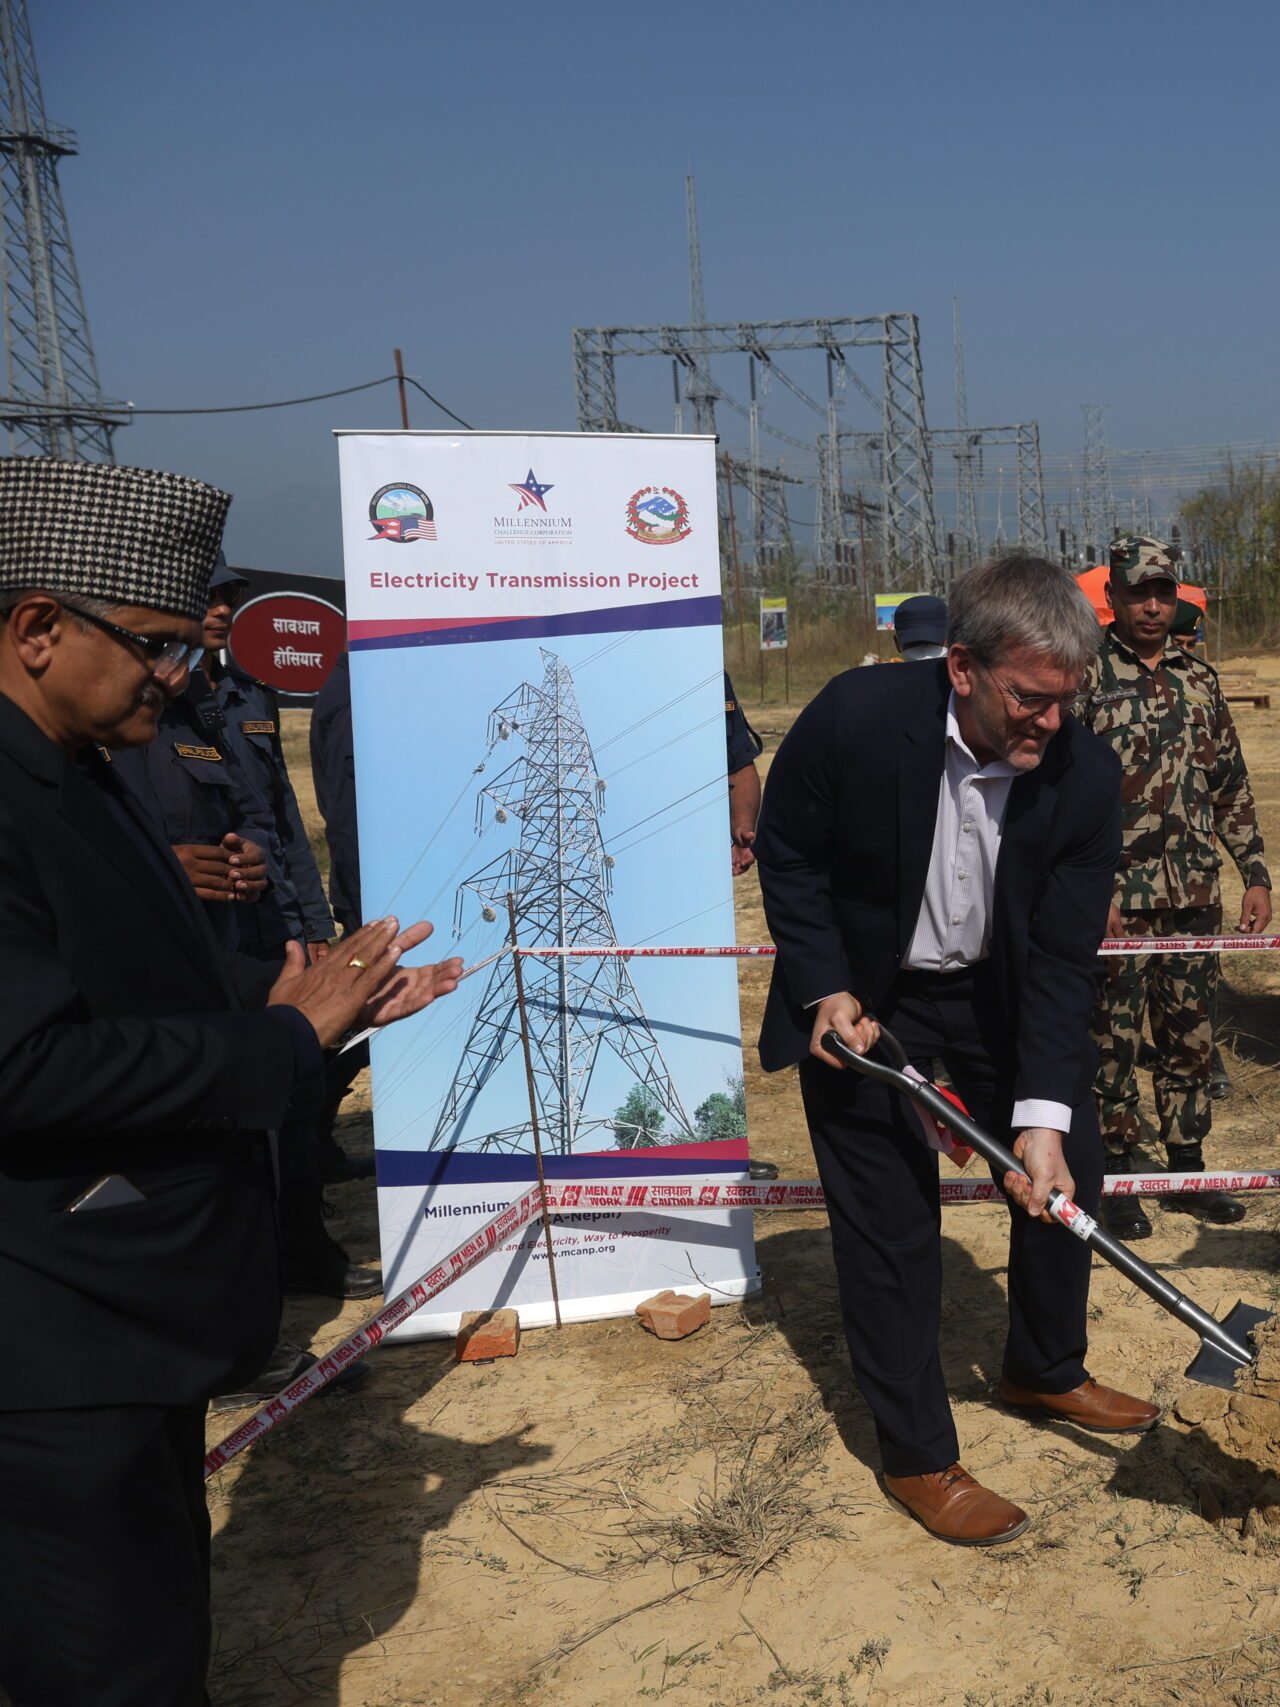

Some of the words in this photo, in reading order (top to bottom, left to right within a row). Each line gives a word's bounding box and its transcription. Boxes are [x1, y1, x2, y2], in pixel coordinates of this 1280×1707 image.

[494, 516, 572, 528] MILLENNIUM
[370, 571, 479, 591] Electricity
[485, 571, 621, 588] Transmission
[627, 571, 699, 591] Project
[272, 618, 320, 636] सावधान
[273, 646, 323, 669] होसियार
[1139, 1179, 1171, 1191] खतरा
[1204, 1177, 1228, 1188] MEN
[1230, 1177, 1244, 1188] AT
[584, 1186, 609, 1196] MEN
[611, 1186, 624, 1196] AT
[650, 1185, 693, 1197] सावधान
[725, 1185, 757, 1197] खतरा
[789, 1186, 813, 1196] MEN
[590, 1197, 623, 1206] WORK
[651, 1197, 695, 1206] CAUTION
[722, 1197, 762, 1206] DANGER
[424, 1200, 510, 1219] Millennium
[505, 1239, 524, 1251] and
[527, 1236, 580, 1250] Elecricity,
[584, 1232, 606, 1243] Way
[608, 1231, 618, 1240] to
[621, 1226, 672, 1239] Prosperity
[460, 1241, 477, 1260] MEN
[475, 1234, 485, 1248] AT
[377, 1297, 411, 1326] सावधान
[332, 1343, 356, 1363] MEN
[352, 1334, 367, 1349] AT
[283, 1375, 315, 1401] खतरा
[220, 1416, 265, 1451] सावधान
